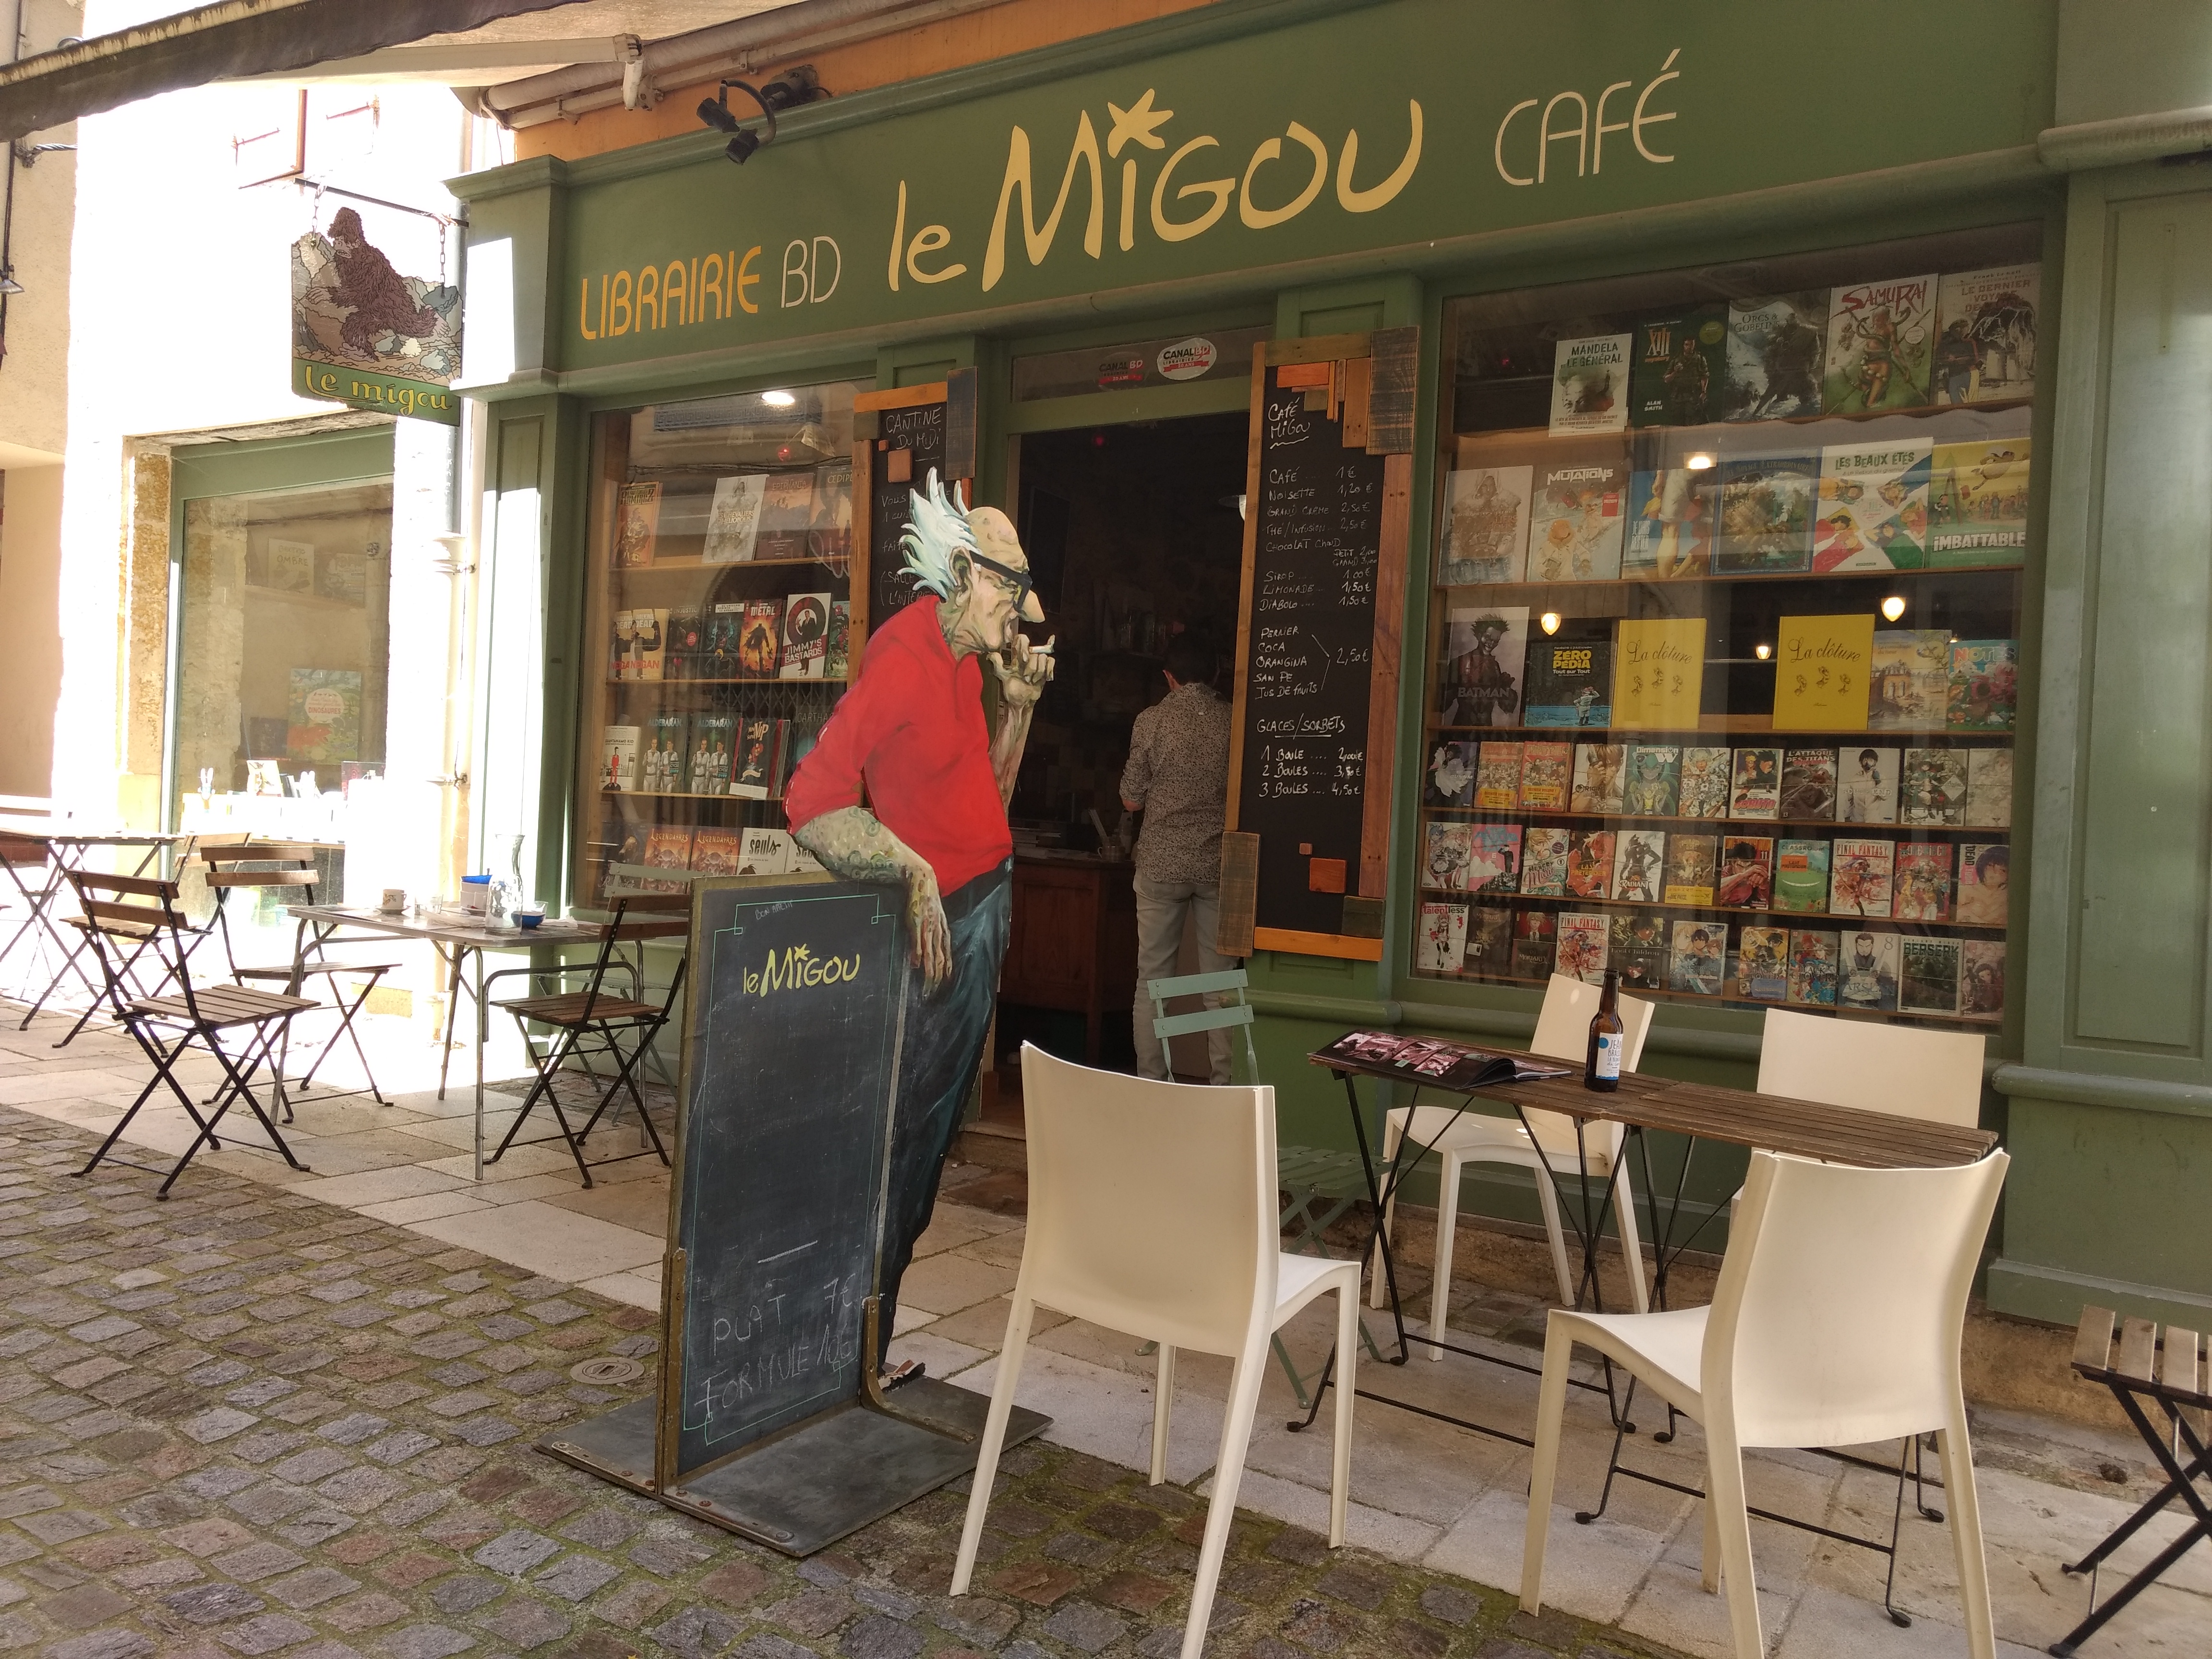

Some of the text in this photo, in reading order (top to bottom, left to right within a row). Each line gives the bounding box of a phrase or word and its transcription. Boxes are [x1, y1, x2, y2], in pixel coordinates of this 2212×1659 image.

[581, 246, 762, 341] LIBRAIRIE
[781, 235, 842, 309] BD
[888, 180, 966, 291] le
[1495, 48, 1681, 186] CAFÉ
[1829, 280, 1928, 320] SAMURAI
[1742, 313, 1769, 324] ORCS
[1571, 342, 1618, 356] MANDELA
[1099, 360, 1143, 372] CANAL BD
[352, 380, 453, 416] migou
[1835, 451, 1915, 470] LES BEAUX ÉTÉS
[1269, 488, 1315, 501] NOISETTE
[1267, 504, 1297, 517] GRAND
[1263, 571, 1295, 582] SIROP
[1262, 583, 1315, 595] LIMONADE
[1259, 598, 1298, 612] DIABOLO
[1261, 626, 1299, 639] PERRIER
[784, 638, 822, 656] JIMMY'S
[1258, 642, 1286, 653] COCA
[1626, 639, 1649, 665] La
[1788, 637, 1814, 663] La
[784, 646, 823, 664] BASTARDS
[1256, 655, 1308, 668] ORANGINA
[1553, 649, 1592, 661] ZÉRO
[1953, 646, 2017, 664] NOTES
[1253, 673, 1274, 683] SAN
[1255, 686, 1274, 700] JUS
[1277, 685, 1292, 697] DE
[1458, 686, 1511, 698] BATMAN
[648, 717, 682, 727] ALDEBARAN
[697, 717, 733, 728] ALDEBARAN
[1261, 745, 1270, 762] 1
[1275, 749, 1304, 762] BOULE
[1655, 753, 1679, 764] W
[1262, 764, 1270, 777] 2
[1274, 762, 1309, 778] BOULES
[1258, 782, 1269, 798] 3
[1272, 783, 1309, 798] BOULES
[1732, 797, 1777, 811] BORUTO
[1760, 851, 1767, 860] 11
[1836, 844, 1888, 855] FINAL FANTASY
[1528, 861, 1555, 873] HUNGRY
[1524, 867, 1556, 891] Marie
[1617, 879, 1653, 890] RADIANT
[1423, 904, 1467, 914] talentless
[1561, 917, 1605, 928] FINAL FANTASY
[1884, 936, 1893, 951] 8
[1903, 942, 1960, 958] BERSERK
[743, 966, 759, 995] le
[694, 1345, 809, 1419] FORMULE
